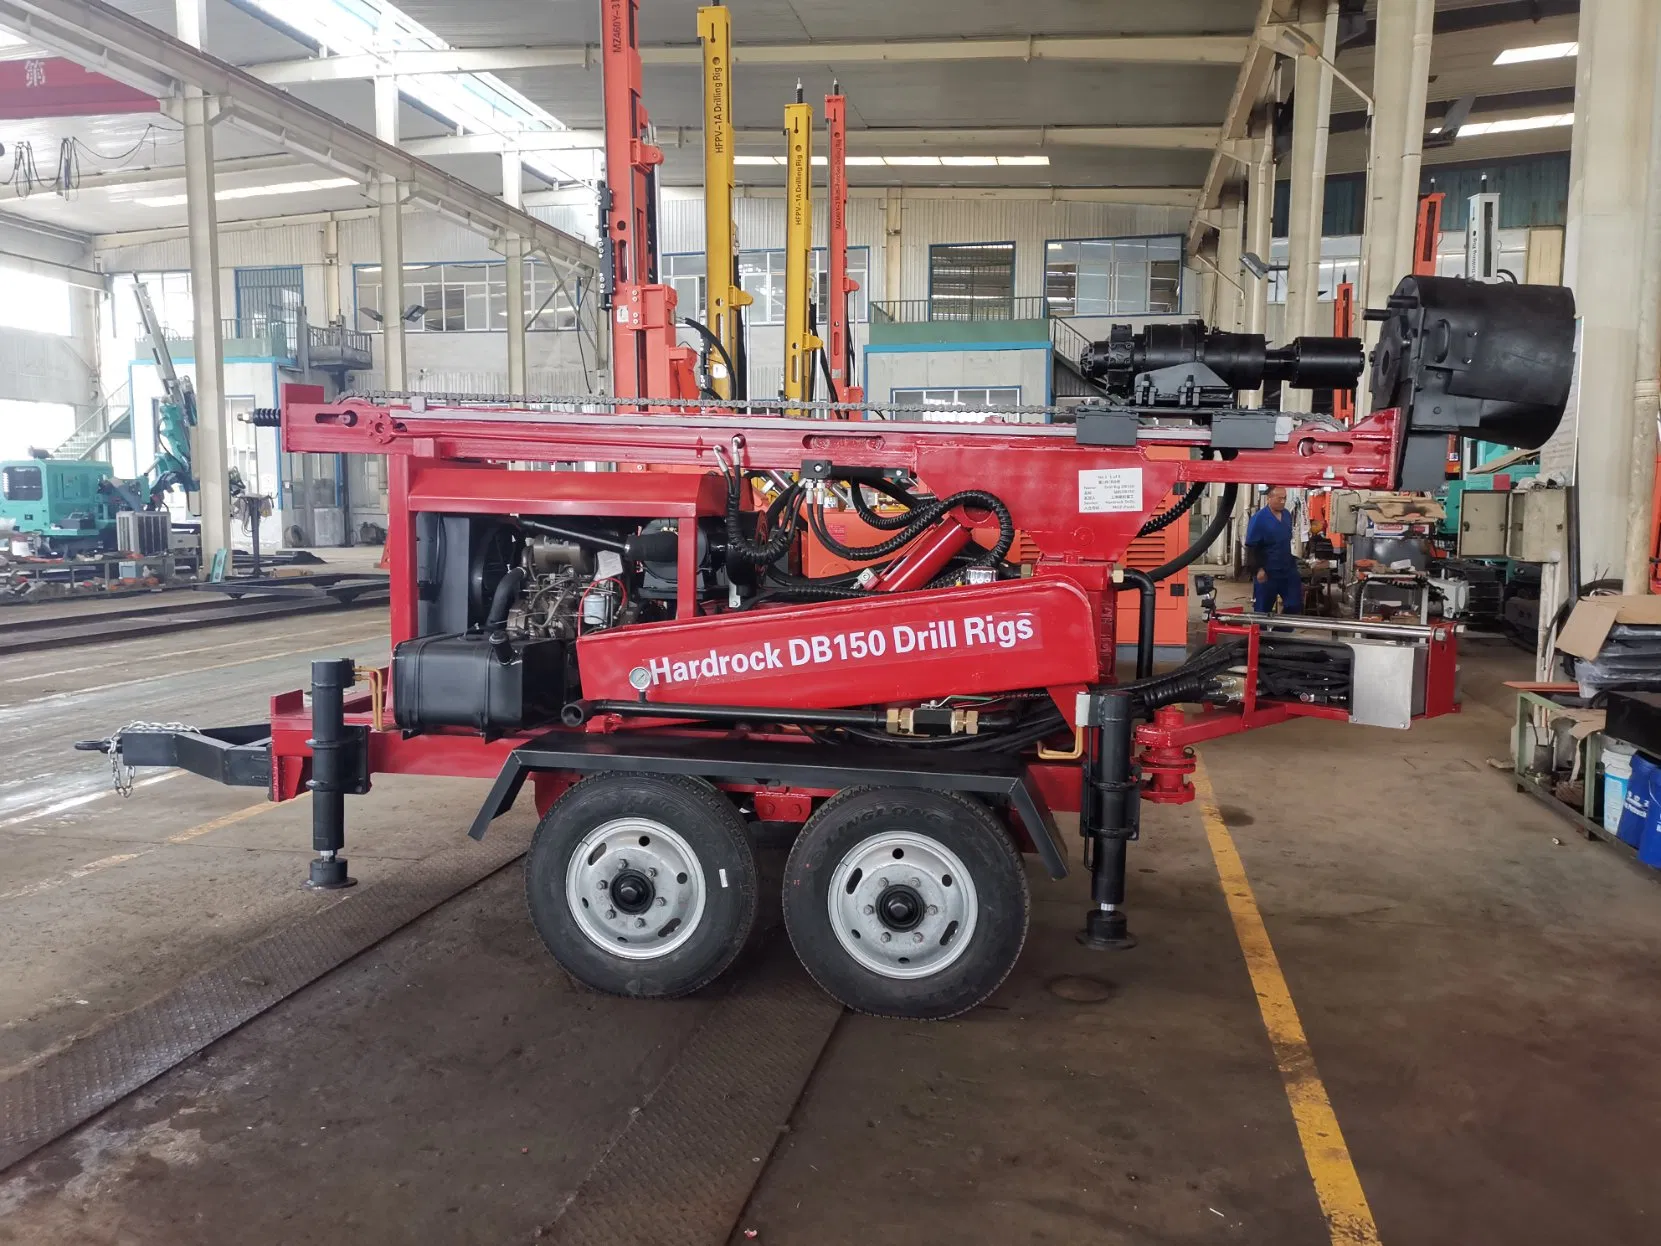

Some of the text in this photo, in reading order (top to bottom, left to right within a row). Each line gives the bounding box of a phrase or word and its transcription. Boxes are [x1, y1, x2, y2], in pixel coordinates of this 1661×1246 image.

[712, 67, 724, 154] HFPV-1A Drilling Rig
[795, 154, 803, 167] Rig
[795, 167, 803, 192] Drilling
[649, 614, 1034, 685] Hardrock DB150 Drill Rigs
